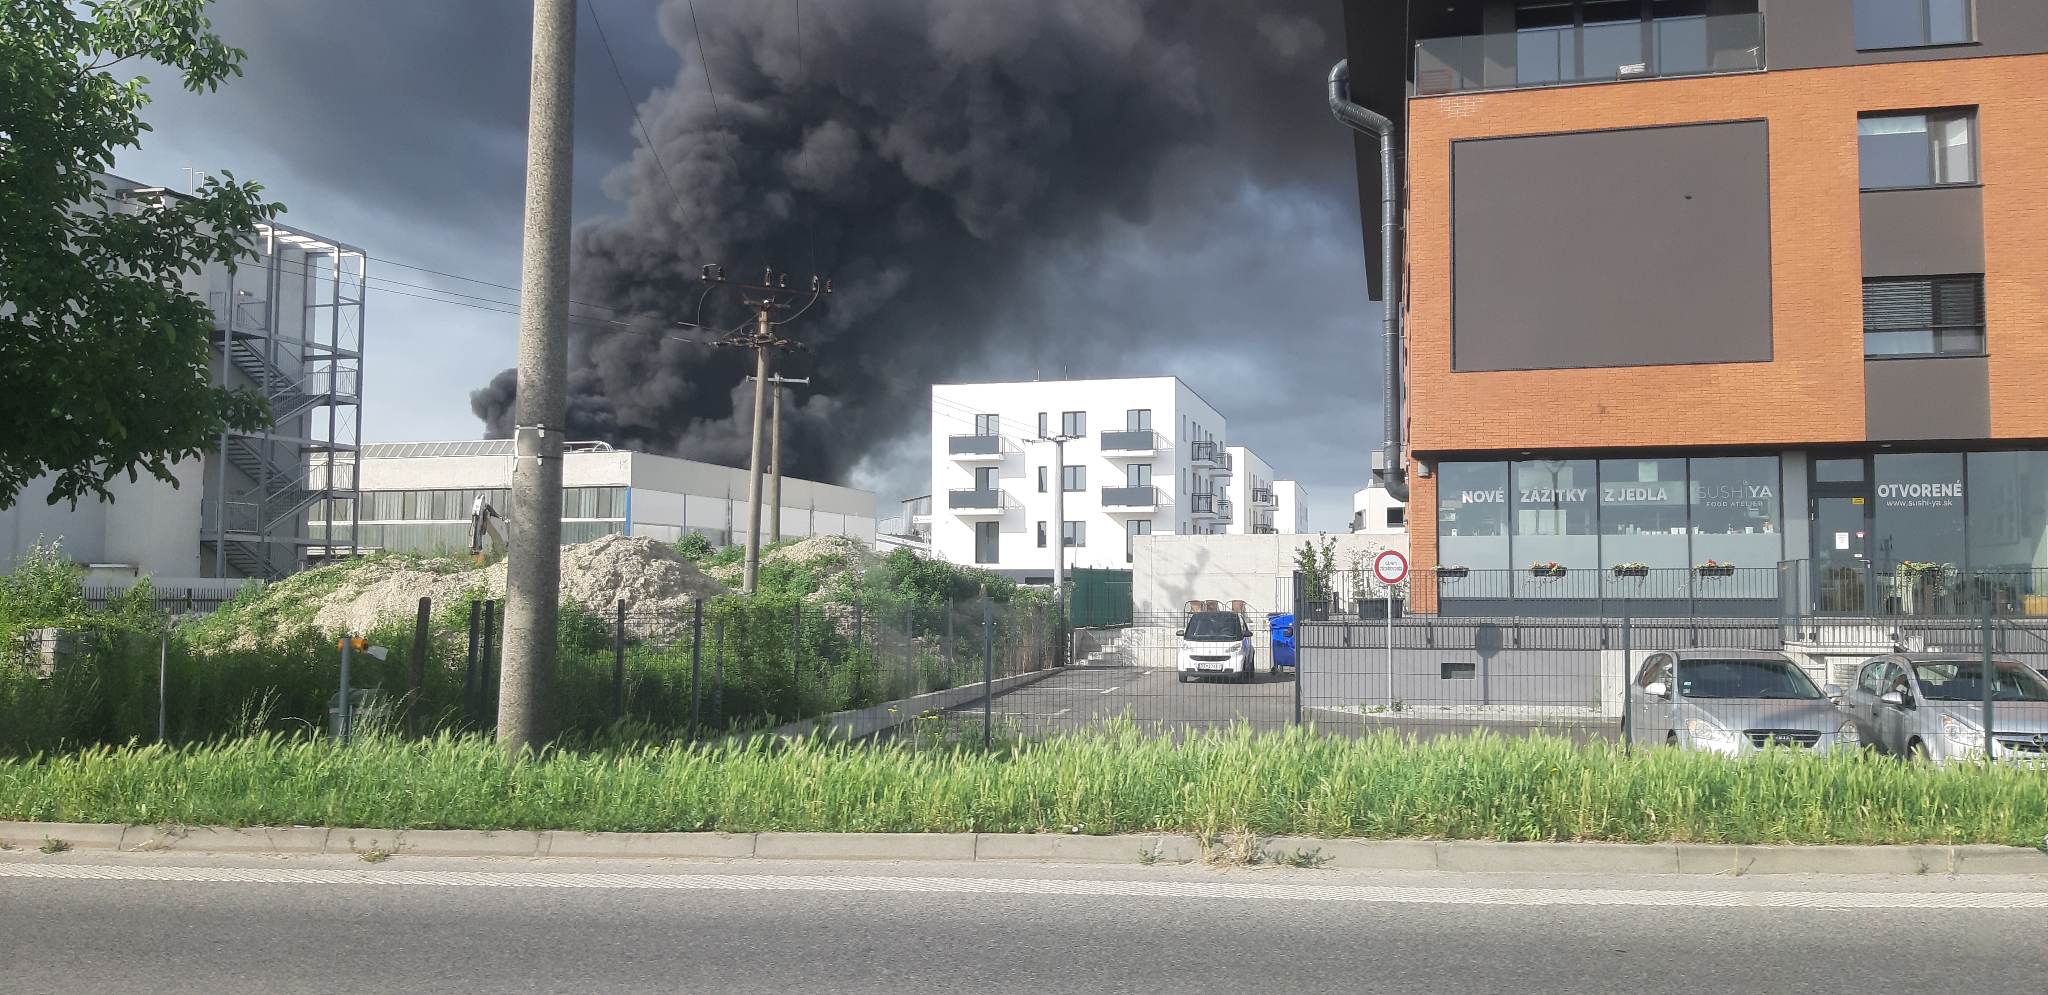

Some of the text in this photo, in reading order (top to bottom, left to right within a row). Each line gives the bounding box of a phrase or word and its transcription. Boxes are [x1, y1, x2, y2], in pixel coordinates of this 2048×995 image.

[1462, 487, 1504, 503] NOVÉ
[1604, 489, 1614, 502] Z
[1617, 488, 1668, 501] JEDLA
[1877, 480, 1962, 498] OTVORENÉ
[1886, 499, 1952, 508] www.sushi-ya.sk
